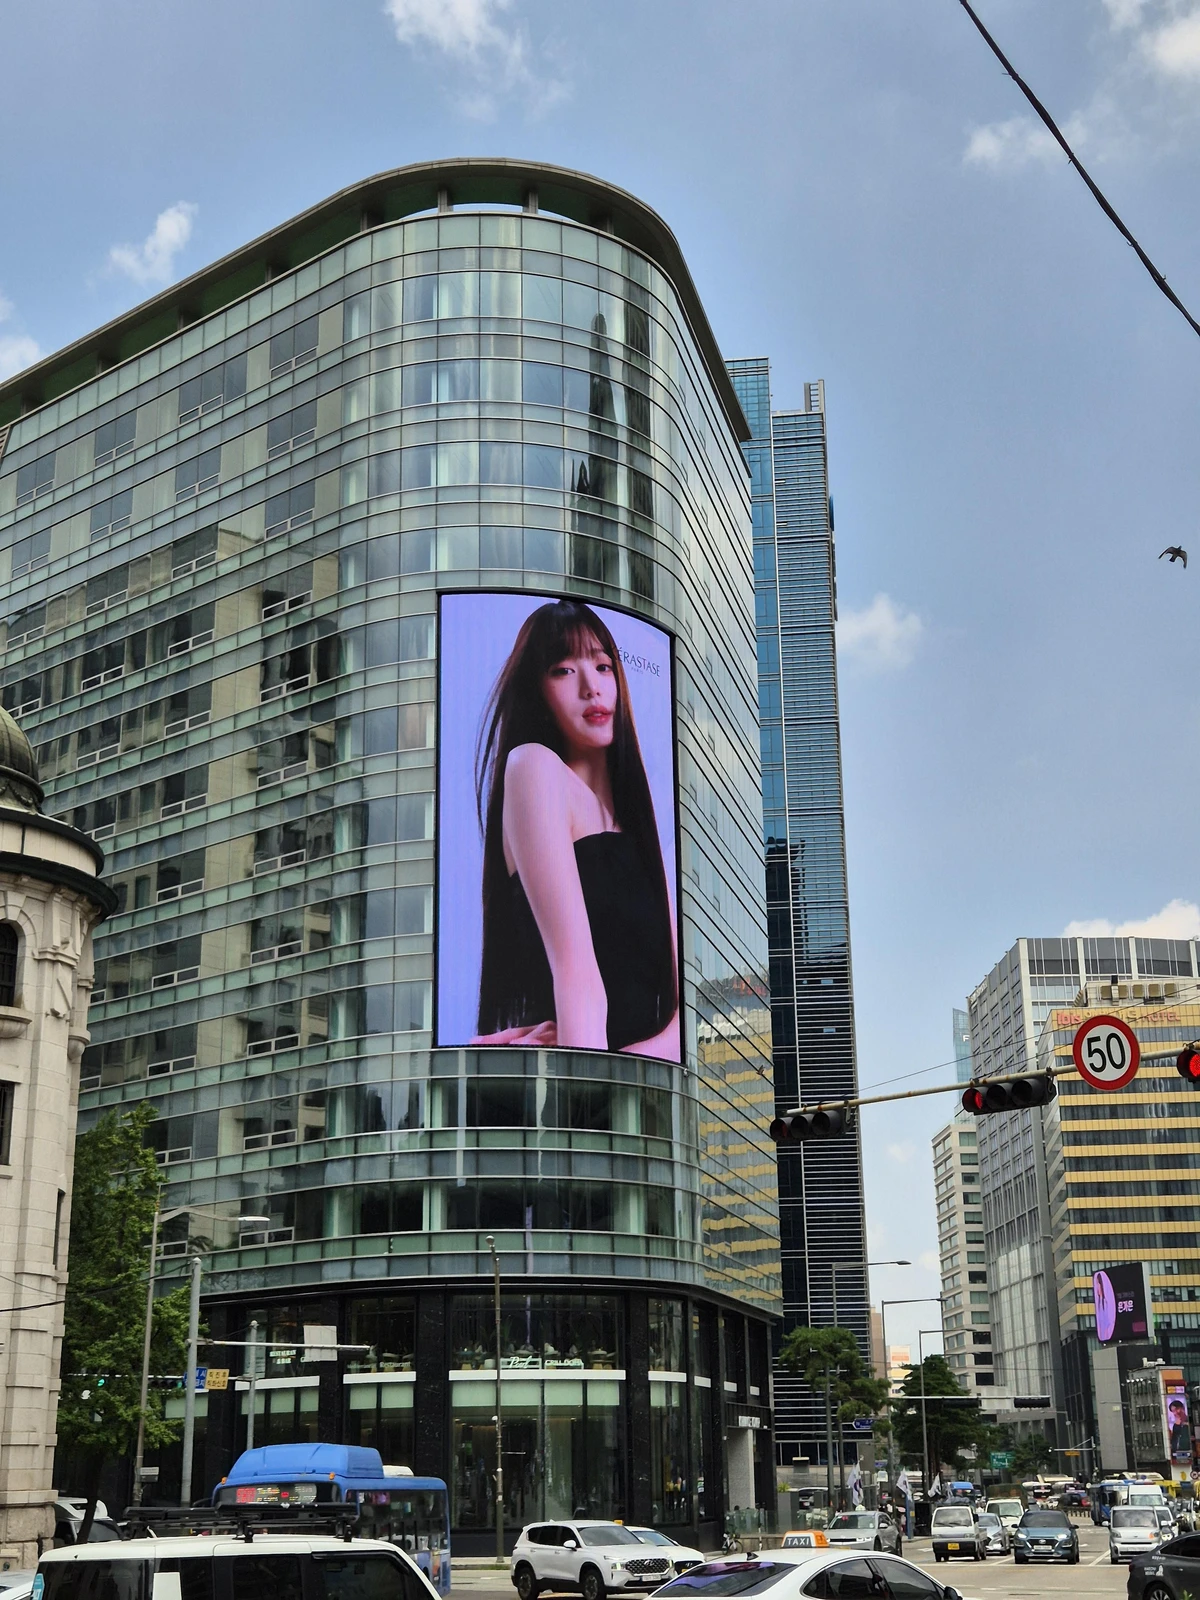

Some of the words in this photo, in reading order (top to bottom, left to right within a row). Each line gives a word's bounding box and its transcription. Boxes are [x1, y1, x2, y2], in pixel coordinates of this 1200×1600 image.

[618, 646, 661, 677] ÉRASTASE
[1056, 1010, 1081, 1025] ibis
[1087, 1032, 1126, 1073] 50
[787, 1537, 810, 1546] TAXI
